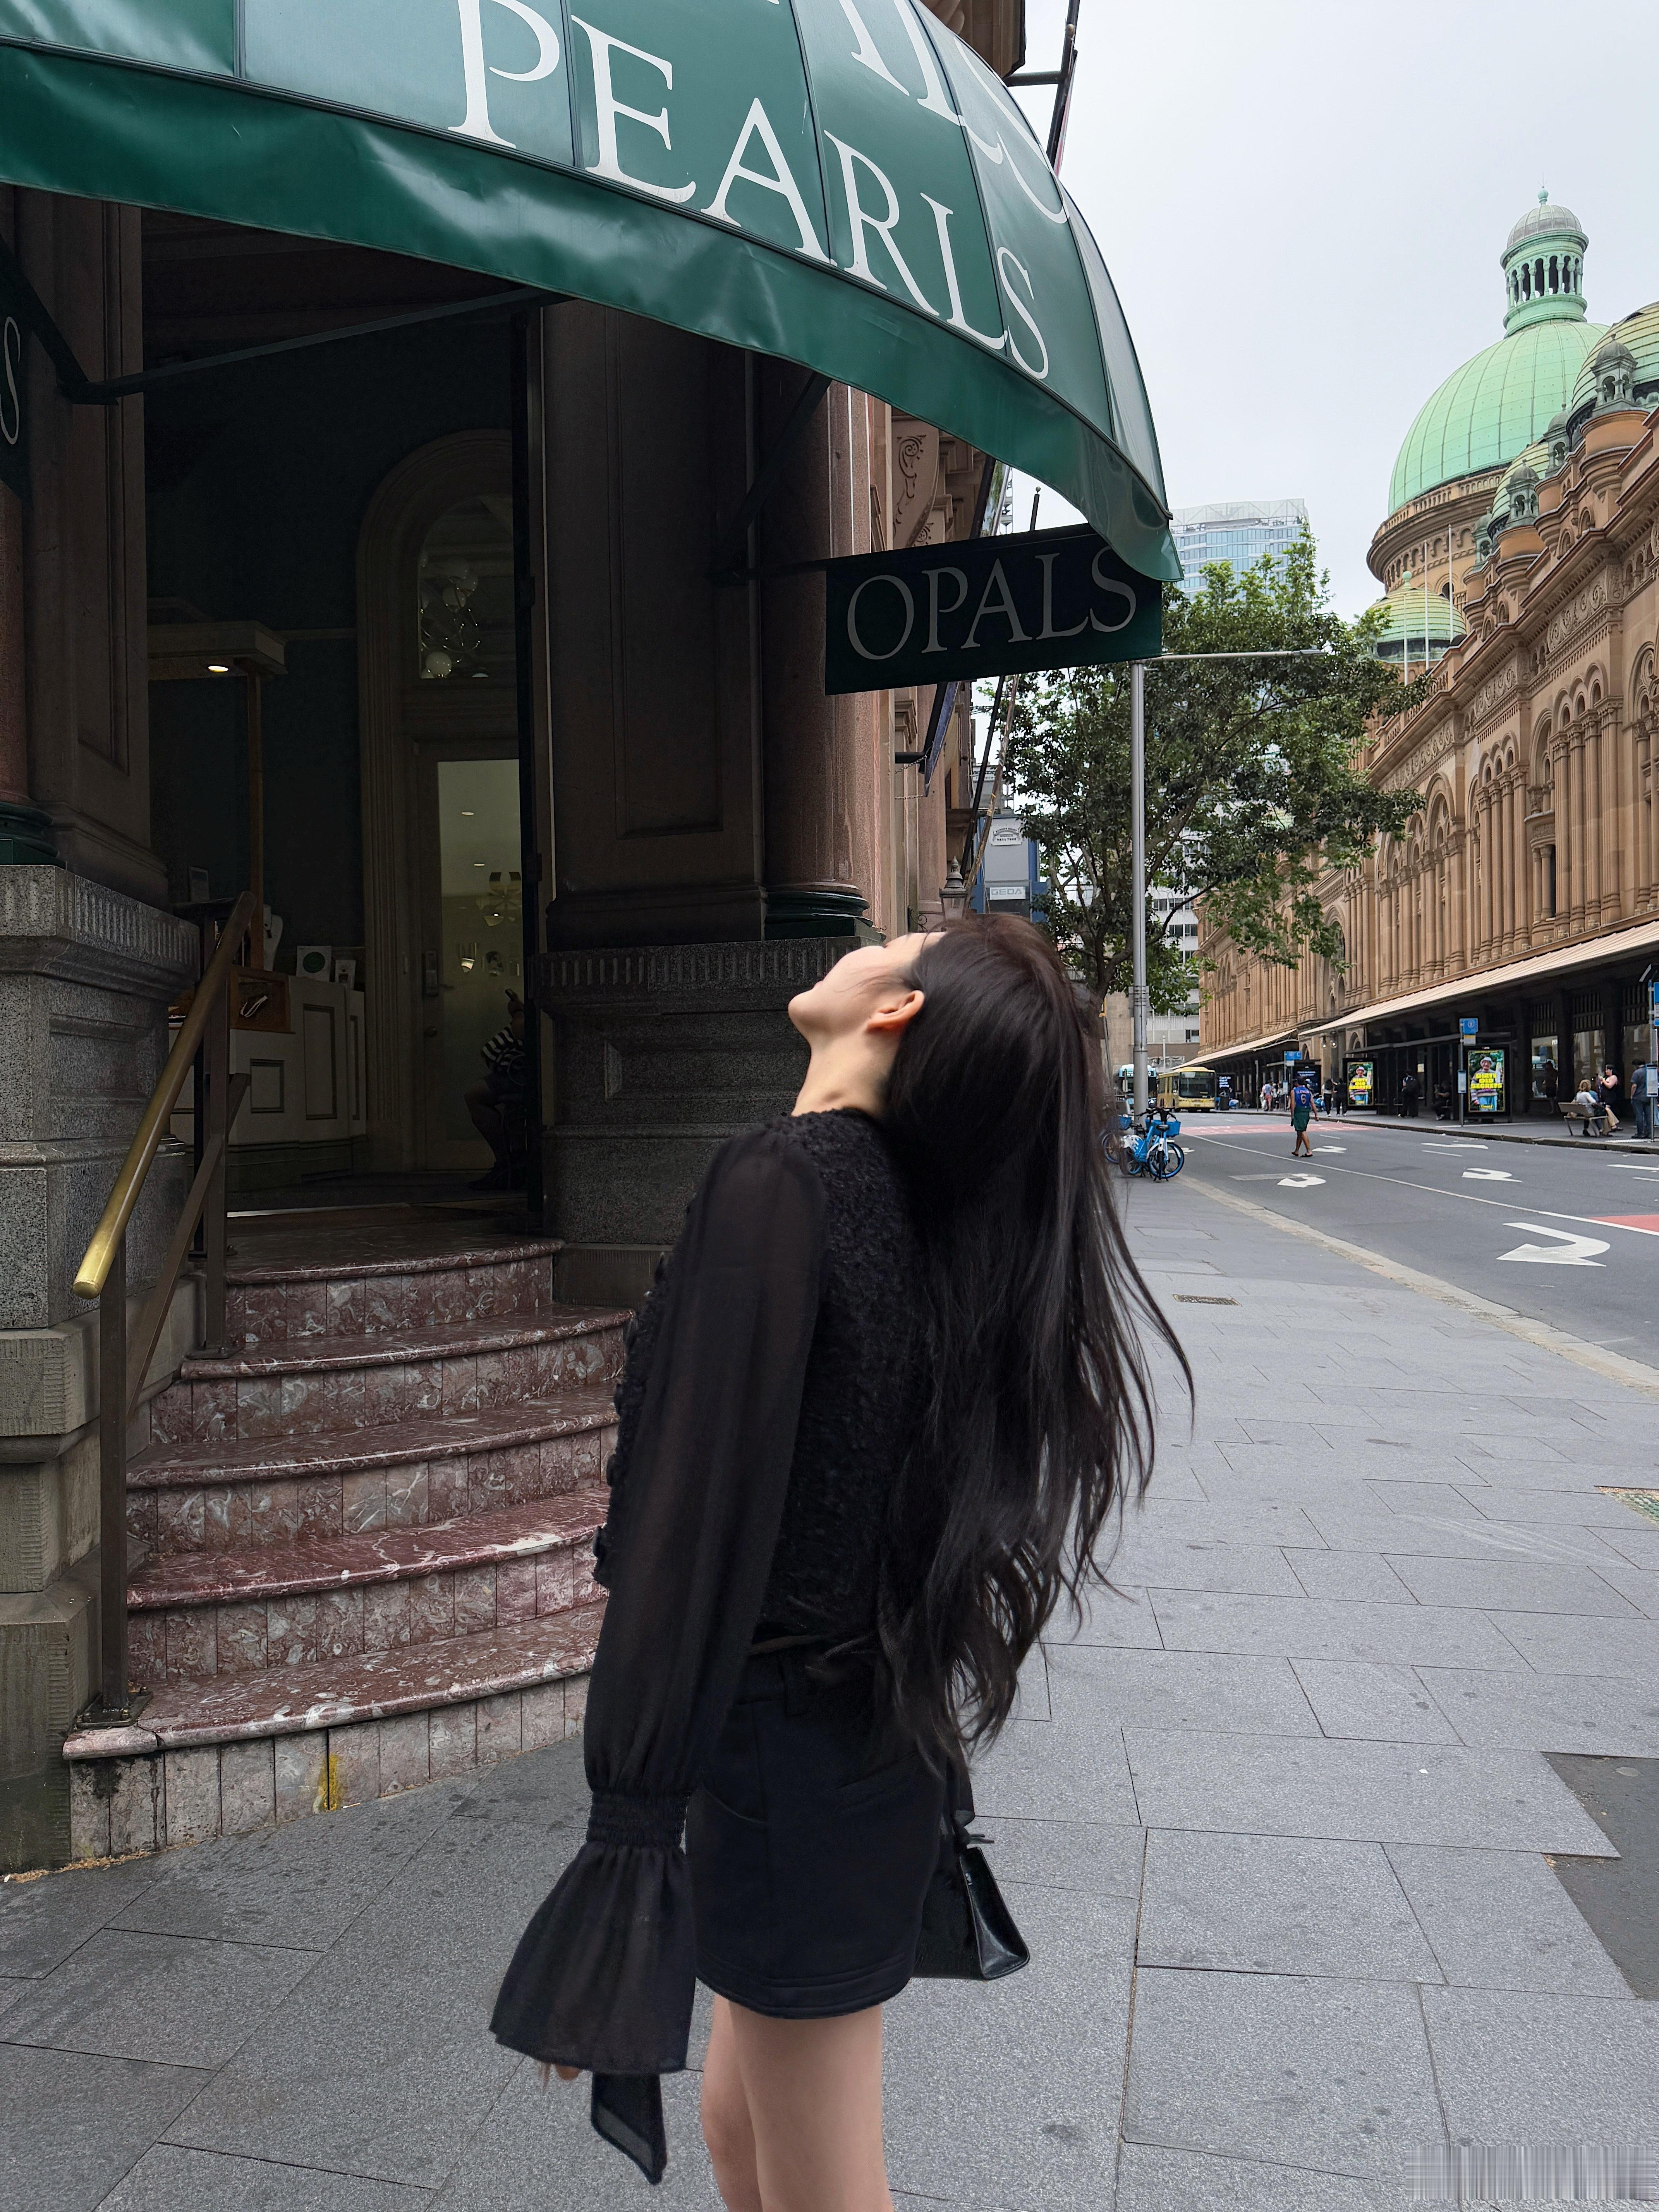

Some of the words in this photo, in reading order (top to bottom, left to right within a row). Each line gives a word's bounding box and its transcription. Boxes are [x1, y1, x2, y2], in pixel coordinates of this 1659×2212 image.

[448, 0, 1049, 380] PEARLS
[847, 546, 1137, 660] OPALS
[1301, 1094, 1306, 1104] 6
